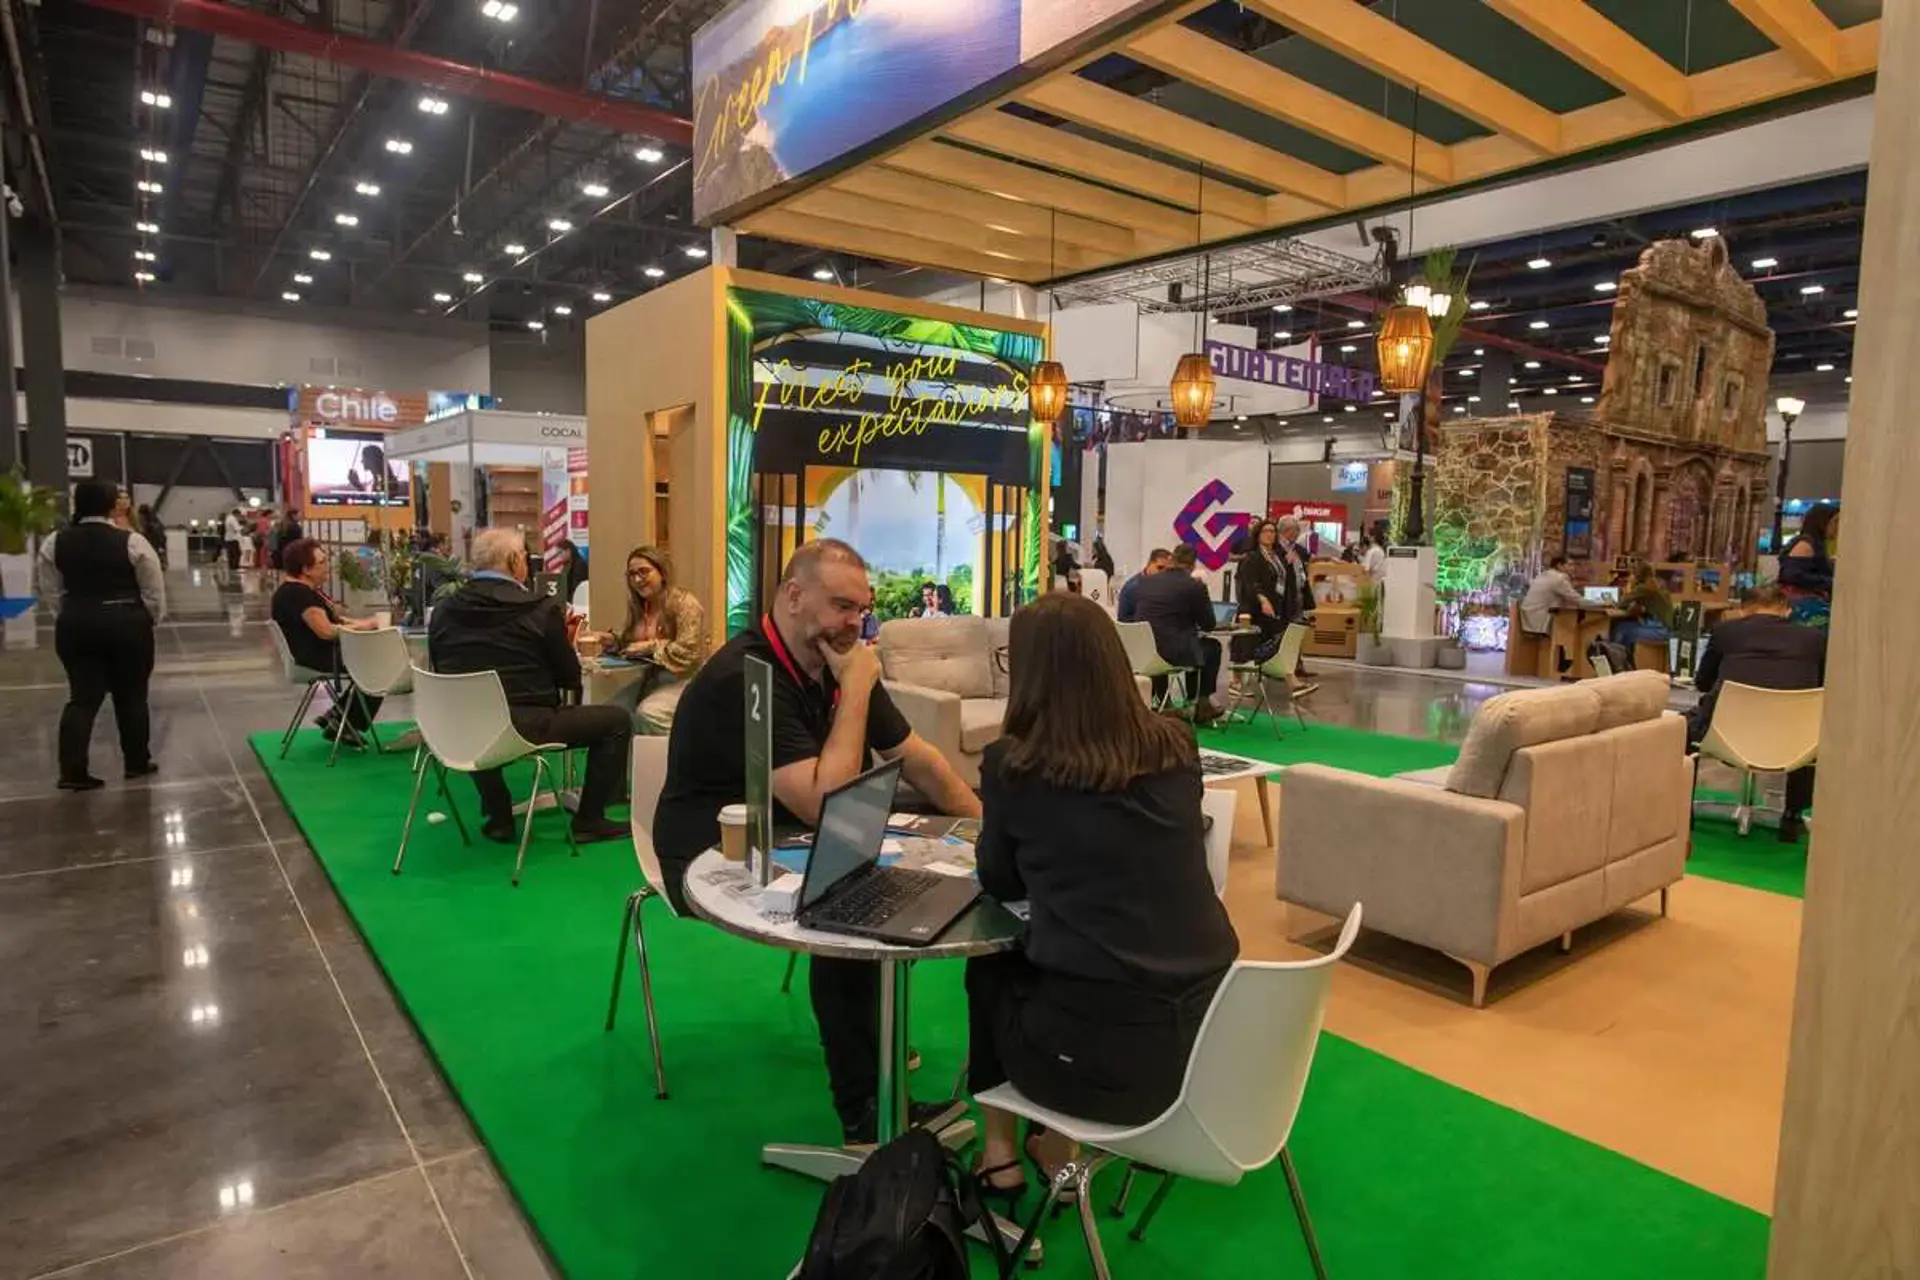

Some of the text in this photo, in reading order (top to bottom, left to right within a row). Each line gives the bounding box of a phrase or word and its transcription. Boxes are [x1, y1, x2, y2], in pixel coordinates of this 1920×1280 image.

[1204, 340, 1375, 403] GUATEMALA
[316, 392, 398, 422] Chile
[752, 350, 957, 432] Meet your
[818, 372, 1030, 466] expectations
[547, 580, 558, 597] 3
[1686, 606, 1695, 623] 7
[751, 684, 761, 721] 2
